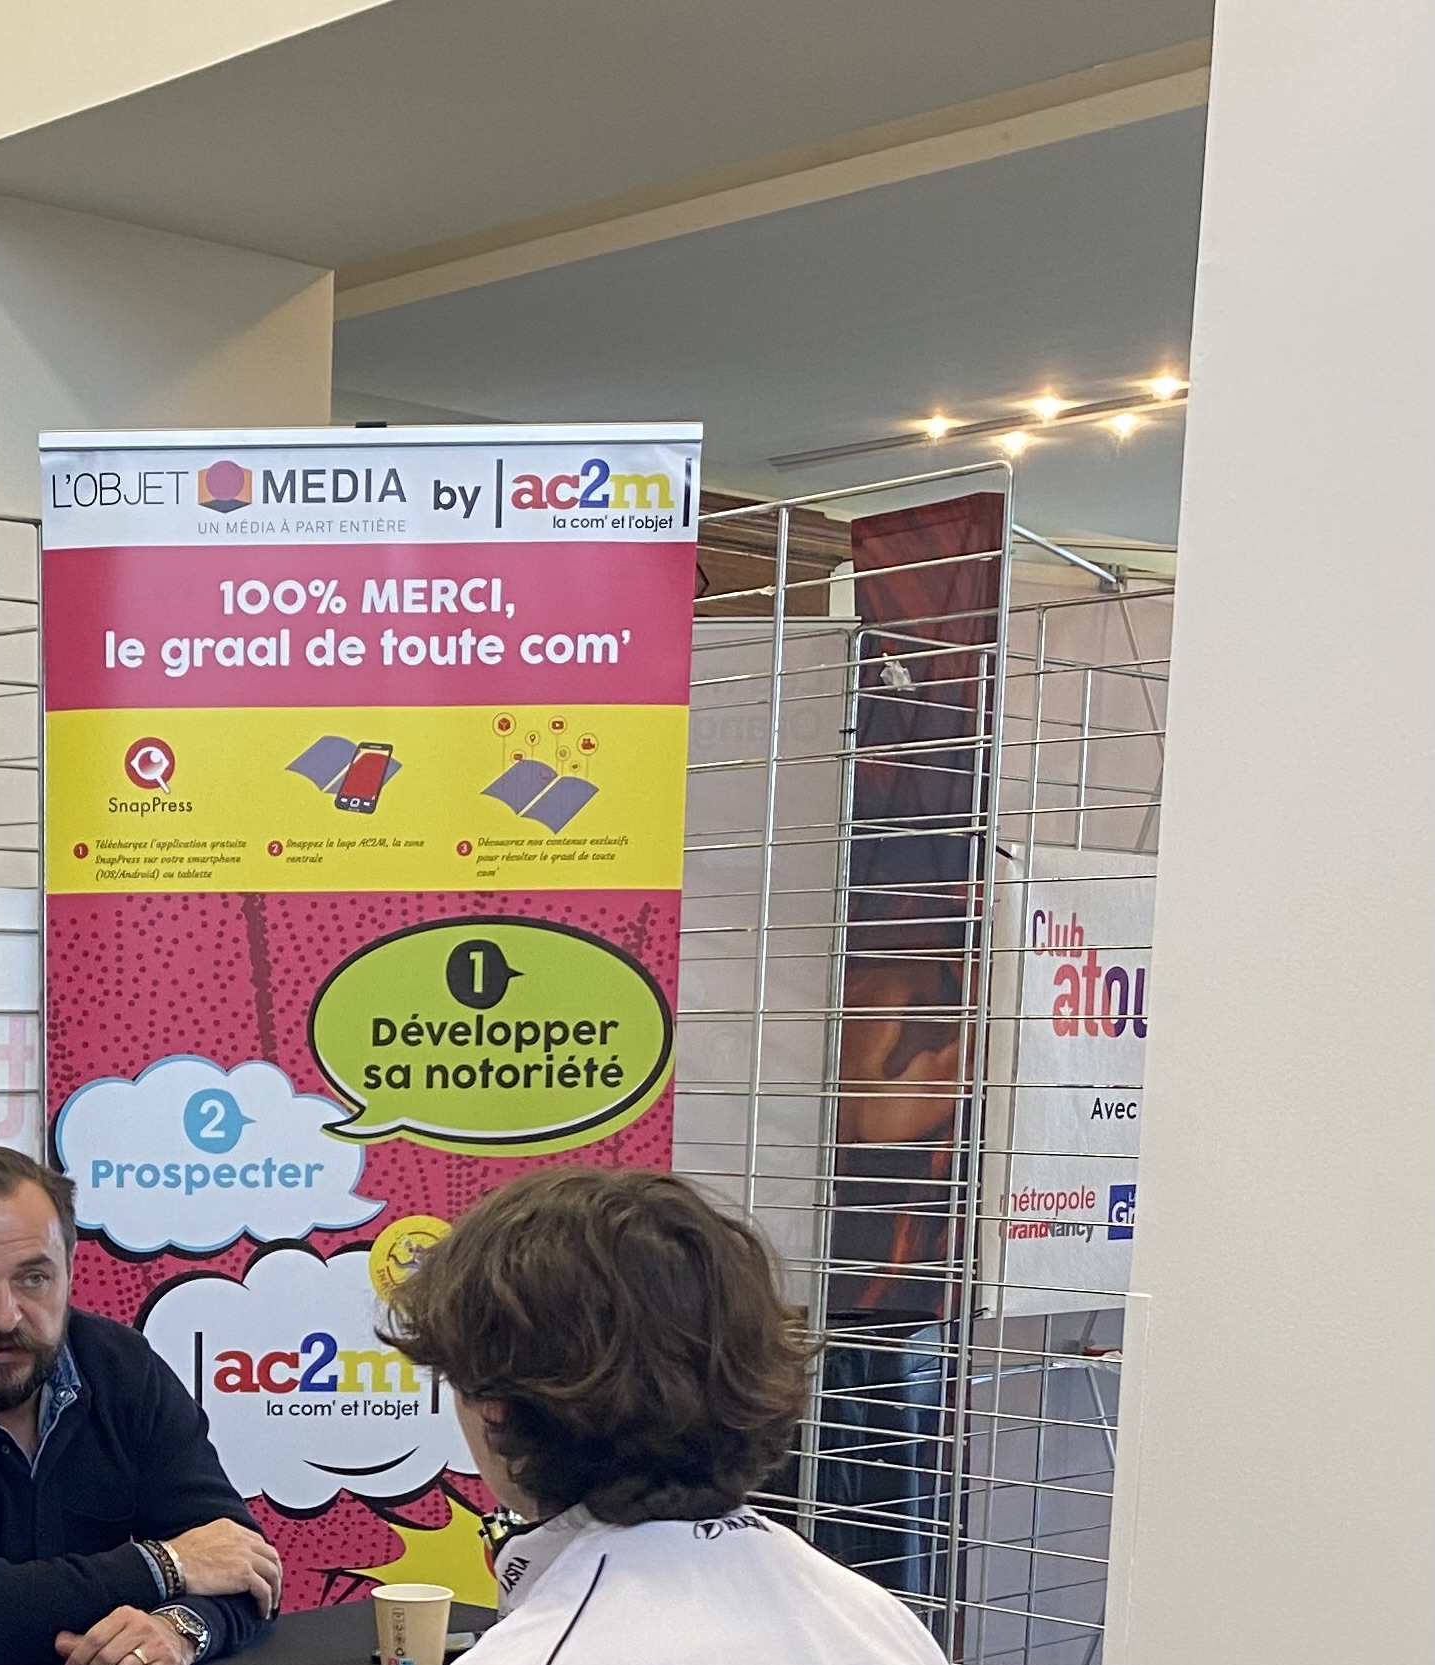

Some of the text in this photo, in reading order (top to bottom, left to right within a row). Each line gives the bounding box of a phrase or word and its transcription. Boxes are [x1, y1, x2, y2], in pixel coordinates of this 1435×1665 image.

[52, 458, 674, 519] L'OBJET MEDIA by ac2m
[197, 517, 407, 535] UN MÉDIA À PART ENTIÈRE
[552, 515, 673, 532] la com' et l'objet
[219, 578, 516, 620] 100% MERCI,
[105, 628, 632, 678] le graal de toute com'
[108, 797, 194, 819] SnapPress
[210, 838, 247, 851] gratuite
[326, 838, 335, 848] le
[337, 838, 356, 850] logo
[392, 837, 401, 847] la
[404, 839, 425, 848] zone
[527, 838, 544, 846] nos
[143, 856, 159, 864] sur
[476, 854, 500, 864] pour
[540, 851, 549, 861] le
[578, 851, 589, 861] de
[591, 851, 616, 861] toute
[163, 871, 174, 879] ou
[1032, 908, 1084, 958] Club
[467, 950, 484, 994] 1
[371, 1013, 619, 1054] Développer
[362, 1055, 624, 1091] sa notoriété
[200, 1099, 226, 1139] 2
[1090, 1097, 1137, 1120] Avec
[91, 1157, 325, 1196] Prospecter
[212, 1331, 421, 1394] ac2m
[266, 1399, 420, 1421] la com' et l'objet
